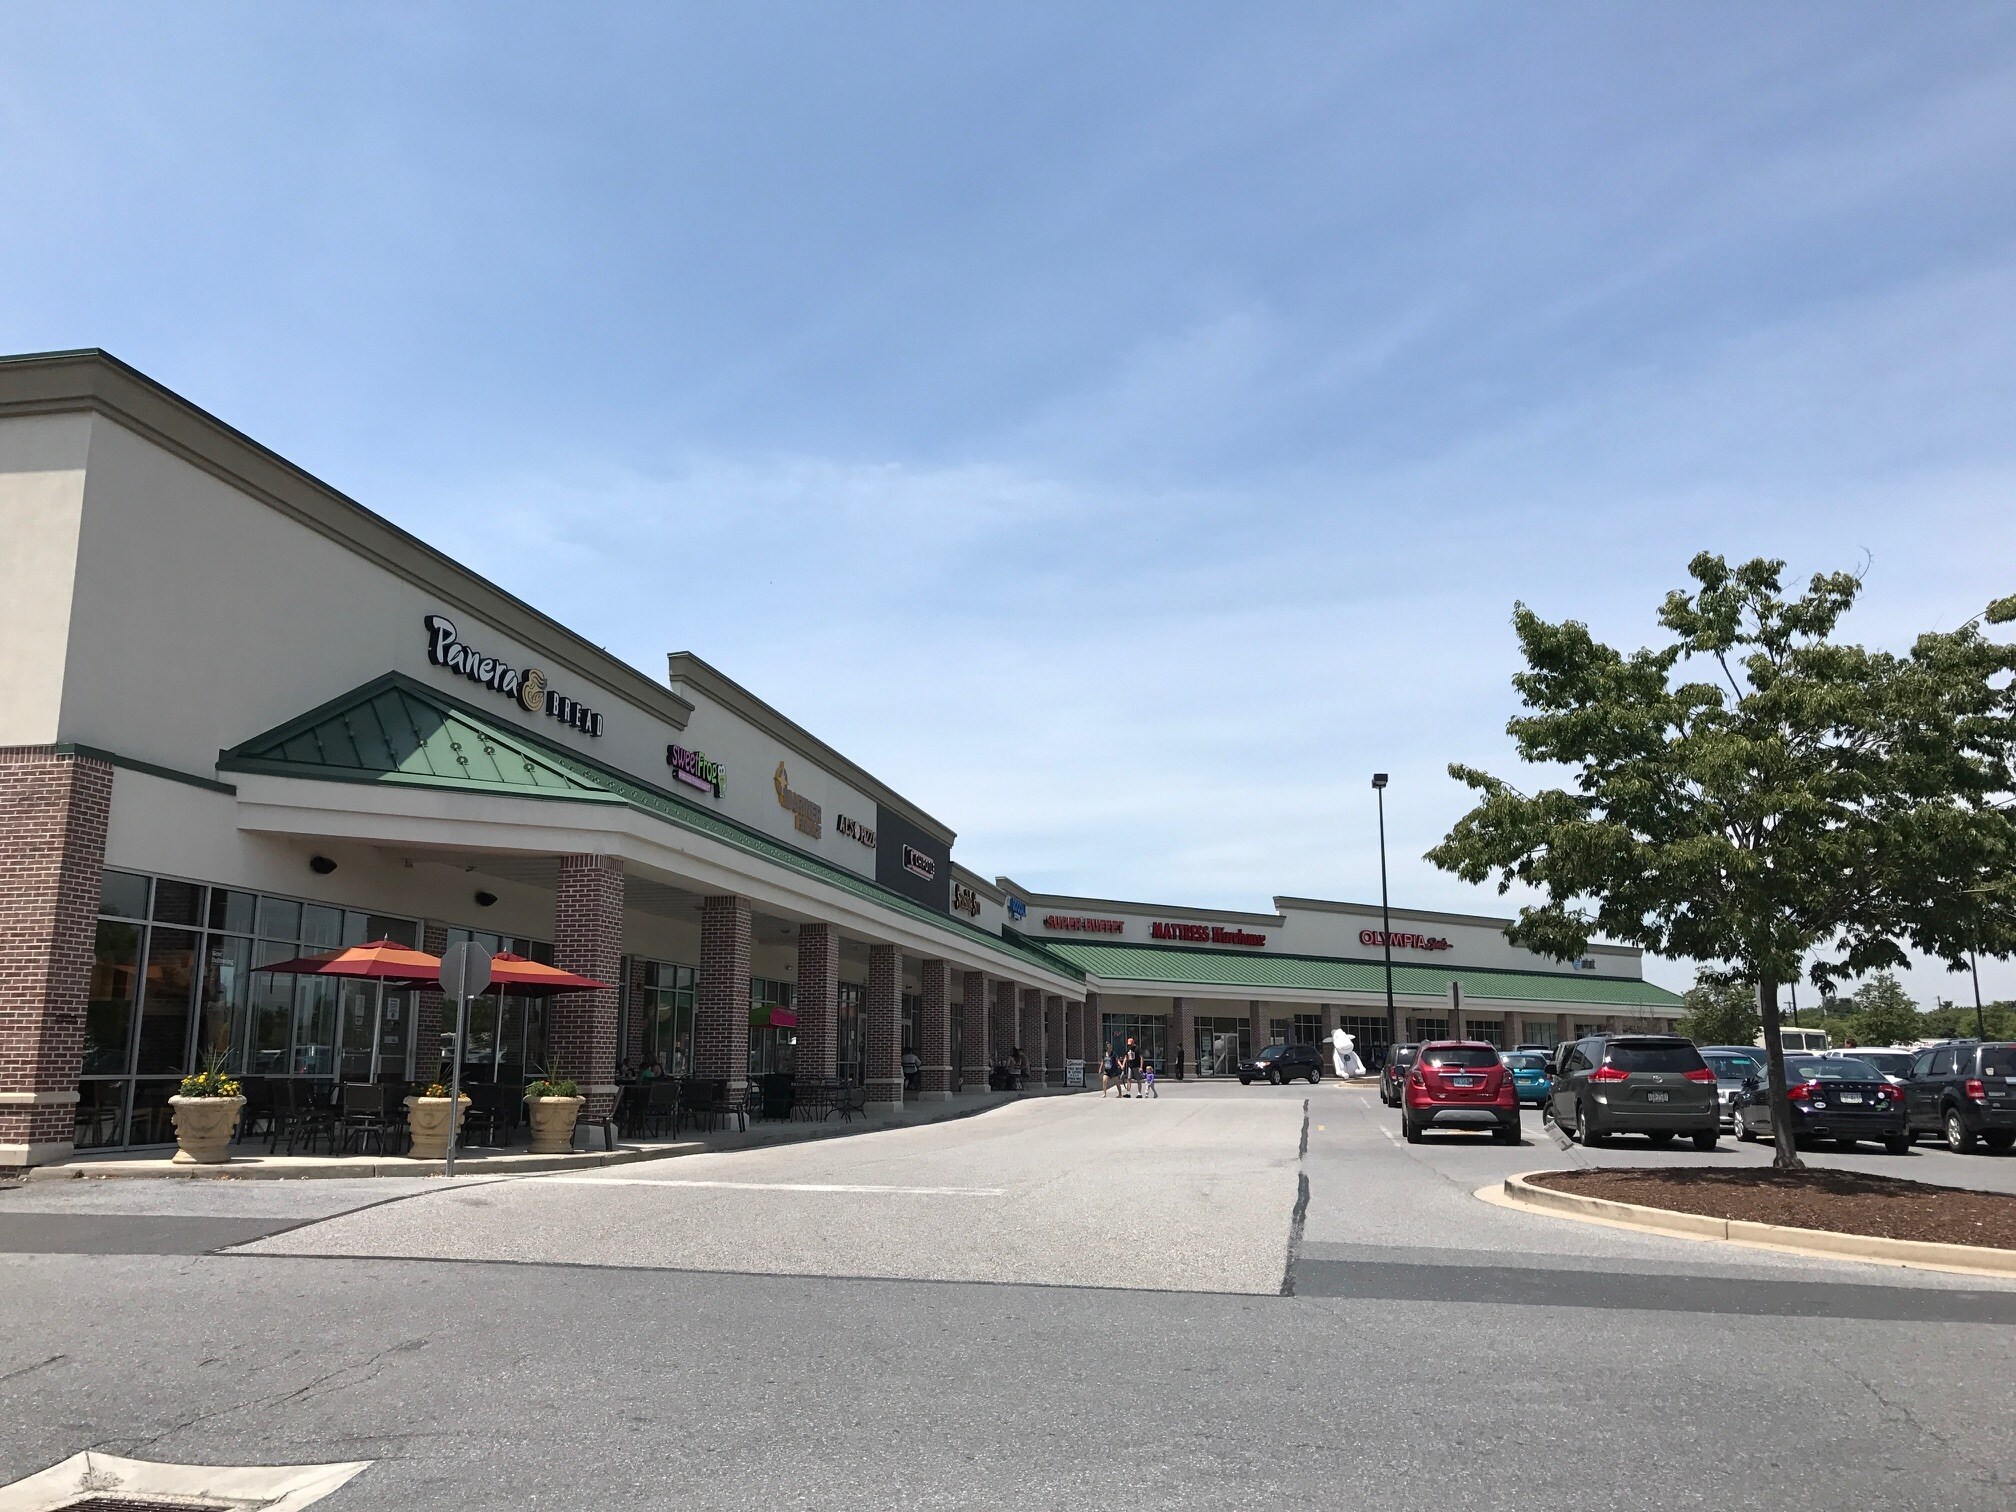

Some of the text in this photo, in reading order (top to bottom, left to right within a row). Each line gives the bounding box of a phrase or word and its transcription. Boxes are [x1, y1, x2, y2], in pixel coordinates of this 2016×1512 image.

[425, 615, 603, 737] Panera BREAD
[1045, 914, 1125, 934] SUPER BUFFET
[1152, 922, 1209, 942] MATTRESS
